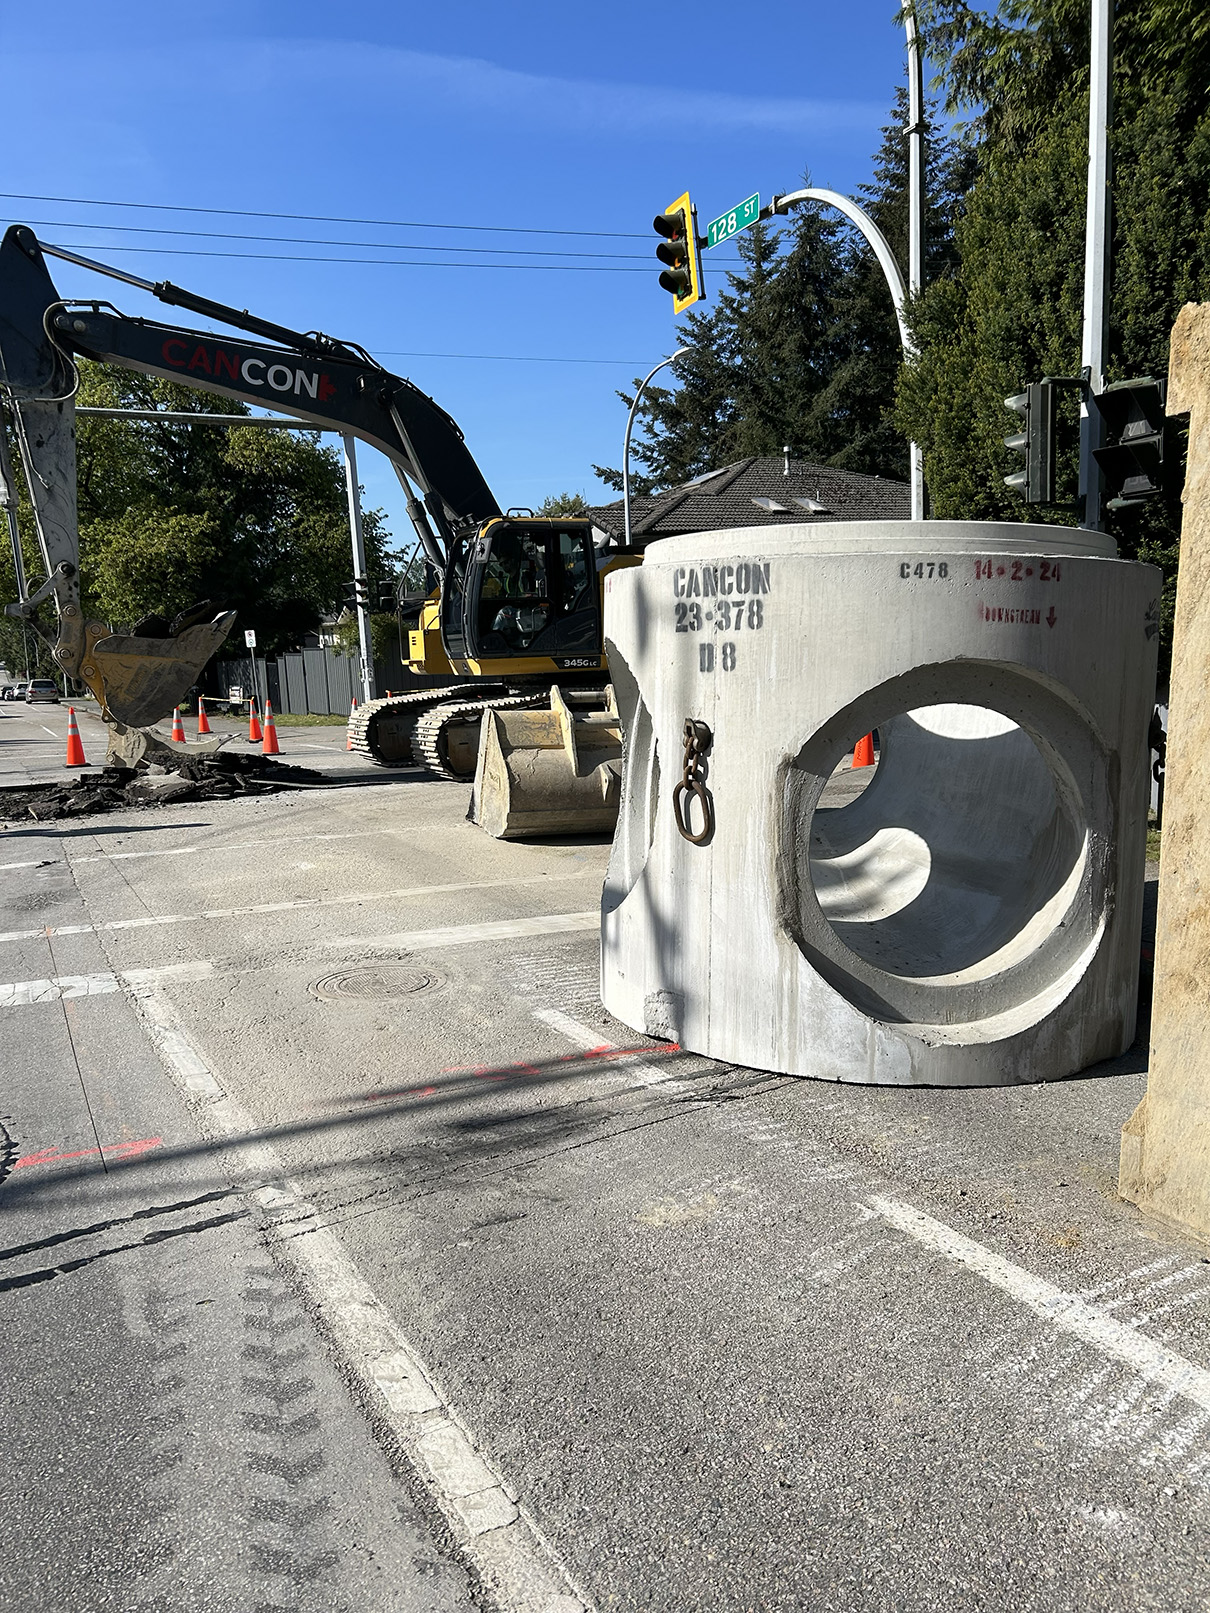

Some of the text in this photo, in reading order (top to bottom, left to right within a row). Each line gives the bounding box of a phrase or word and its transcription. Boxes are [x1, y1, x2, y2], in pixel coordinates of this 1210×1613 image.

[711, 200, 755, 243] 128 ST
[162, 339, 319, 399] CANCON
[673, 563, 771, 598] CANCON
[900, 562, 949, 579] C478
[564, 659, 589, 667] 345G
[699, 642, 736, 673] D 8
